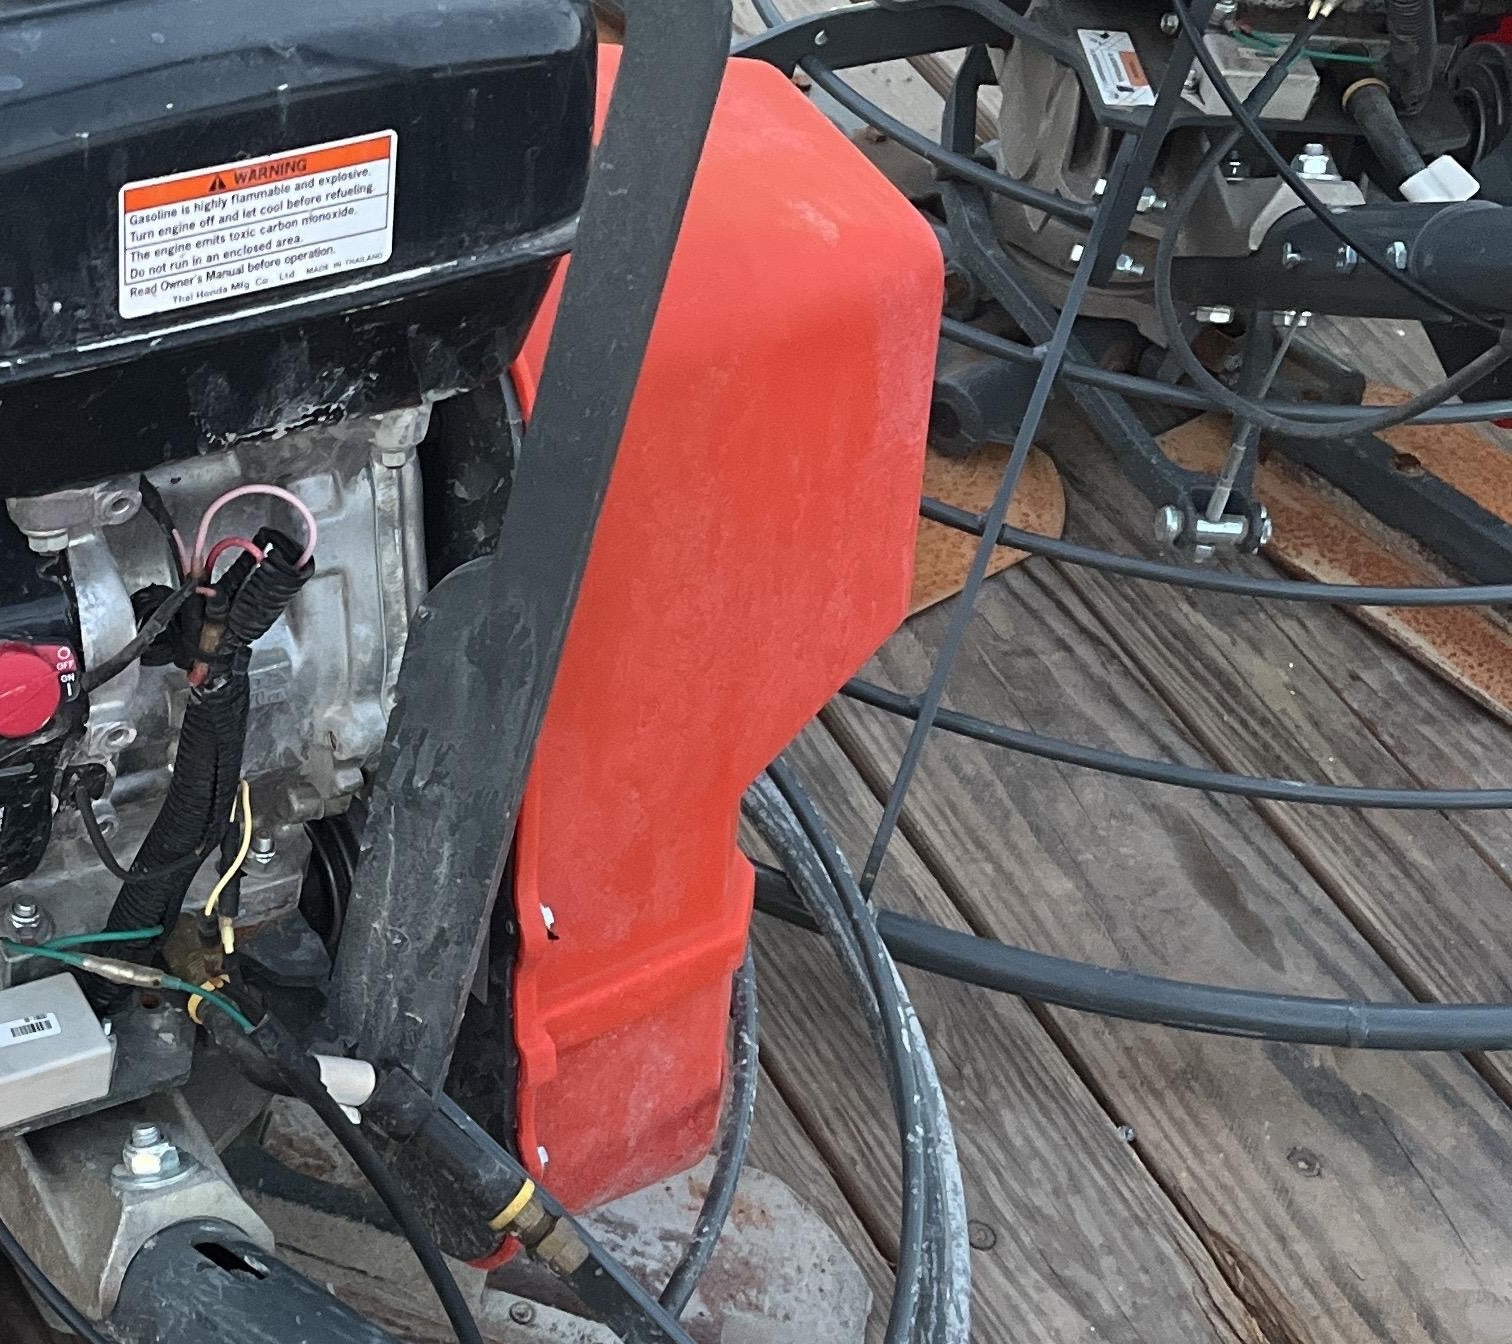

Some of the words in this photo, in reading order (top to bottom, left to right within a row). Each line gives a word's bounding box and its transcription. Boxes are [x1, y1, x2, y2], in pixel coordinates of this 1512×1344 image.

[129, 207, 178, 226] Gasoline
[181, 205, 191, 215] is
[194, 196, 228, 213] highly
[231, 183, 294, 205] flammable
[294, 177, 315, 192] and
[318, 167, 372, 186] explosive.
[234, 158, 307, 185] WARNING
[129, 230, 155, 243] Turn
[158, 221, 196, 236] engine
[199, 215, 215, 228] off
[218, 210, 239, 224] and
[242, 207, 257, 219] let
[260, 200, 283, 216] cool
[287, 193, 322, 210] before
[129, 250, 150, 263] The
[154, 241, 192, 256] engine
[195, 232, 226, 248] emits
[229, 225, 256, 241] toxic
[259, 217, 298, 235] carbon
[301, 206, 357, 225] monoxide.
[129, 282, 158, 298] Read
[160, 273, 203, 292] Owner's
[206, 263, 245, 281] Manual
[247, 257, 281, 274] before
[284, 245, 336, 265] operation.
[130, 268, 145, 280] Do
[148, 262, 167, 276] not
[169, 259, 189, 271] run
[192, 254, 202, 265] in
[205, 253, 220, 264] an
[223, 240, 272, 259] enclosed
[275, 234, 304, 248] area.
